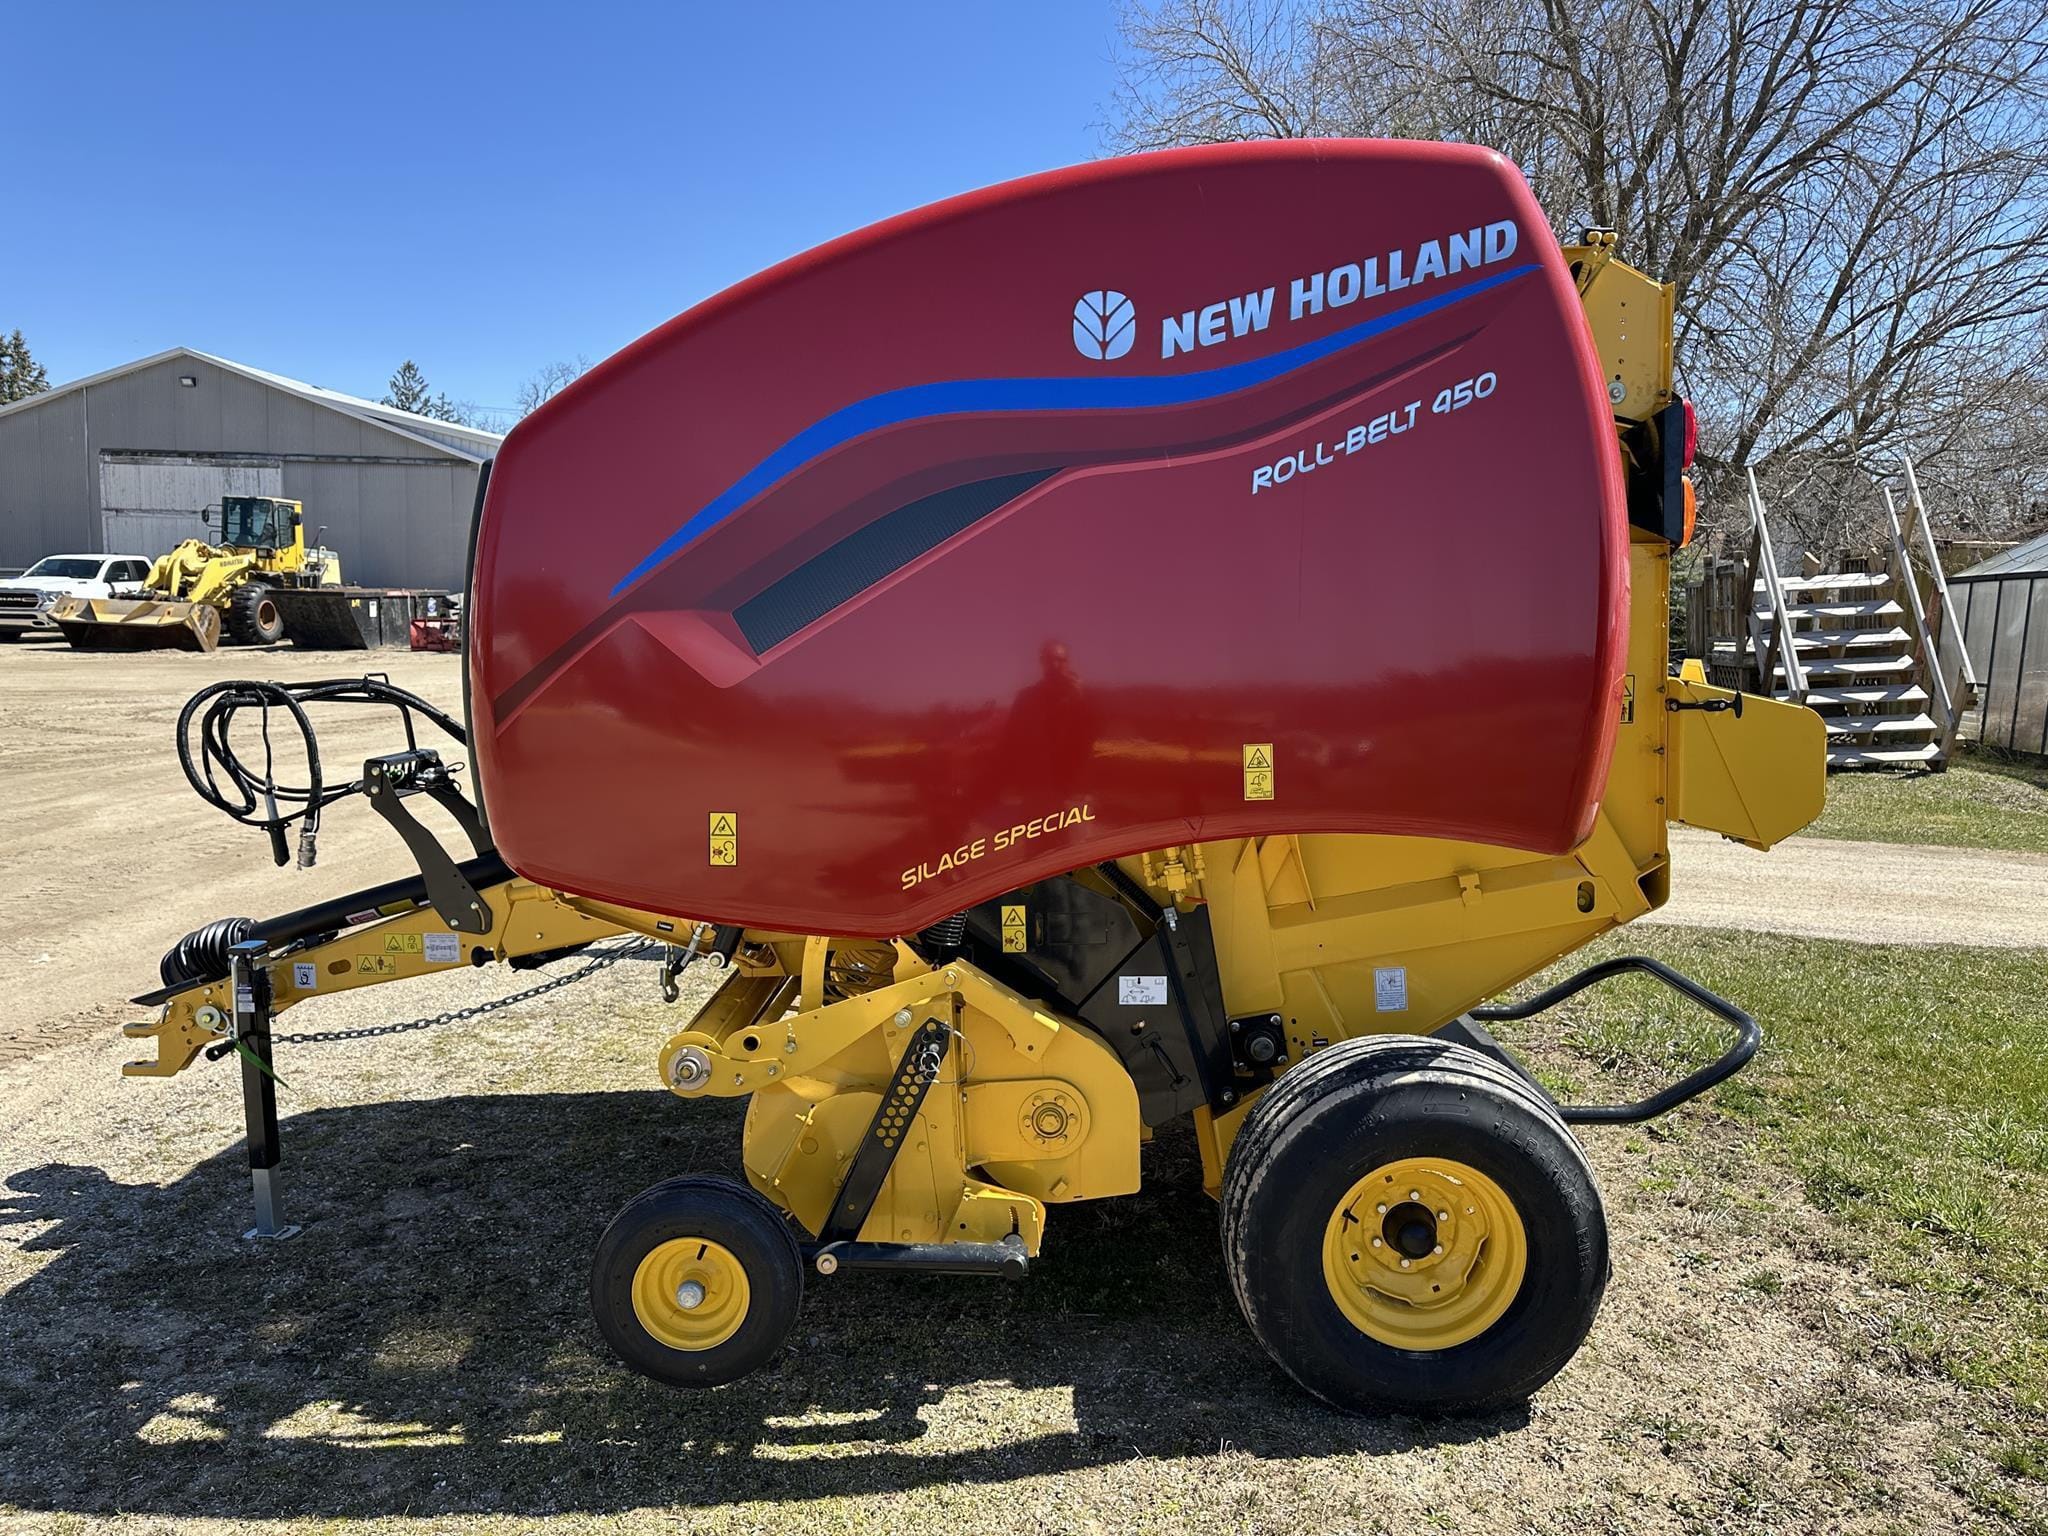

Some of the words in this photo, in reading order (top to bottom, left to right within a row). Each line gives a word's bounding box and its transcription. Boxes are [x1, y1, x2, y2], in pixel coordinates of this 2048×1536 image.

[1161, 287, 1275, 359] NEW
[1289, 219, 1518, 321] HOLLAND
[1252, 400, 1421, 495] ROLL-BELT
[1432, 371, 1497, 414] 450
[901, 838, 985, 890] SILAGE
[994, 804, 1096, 852] SPECIAL
